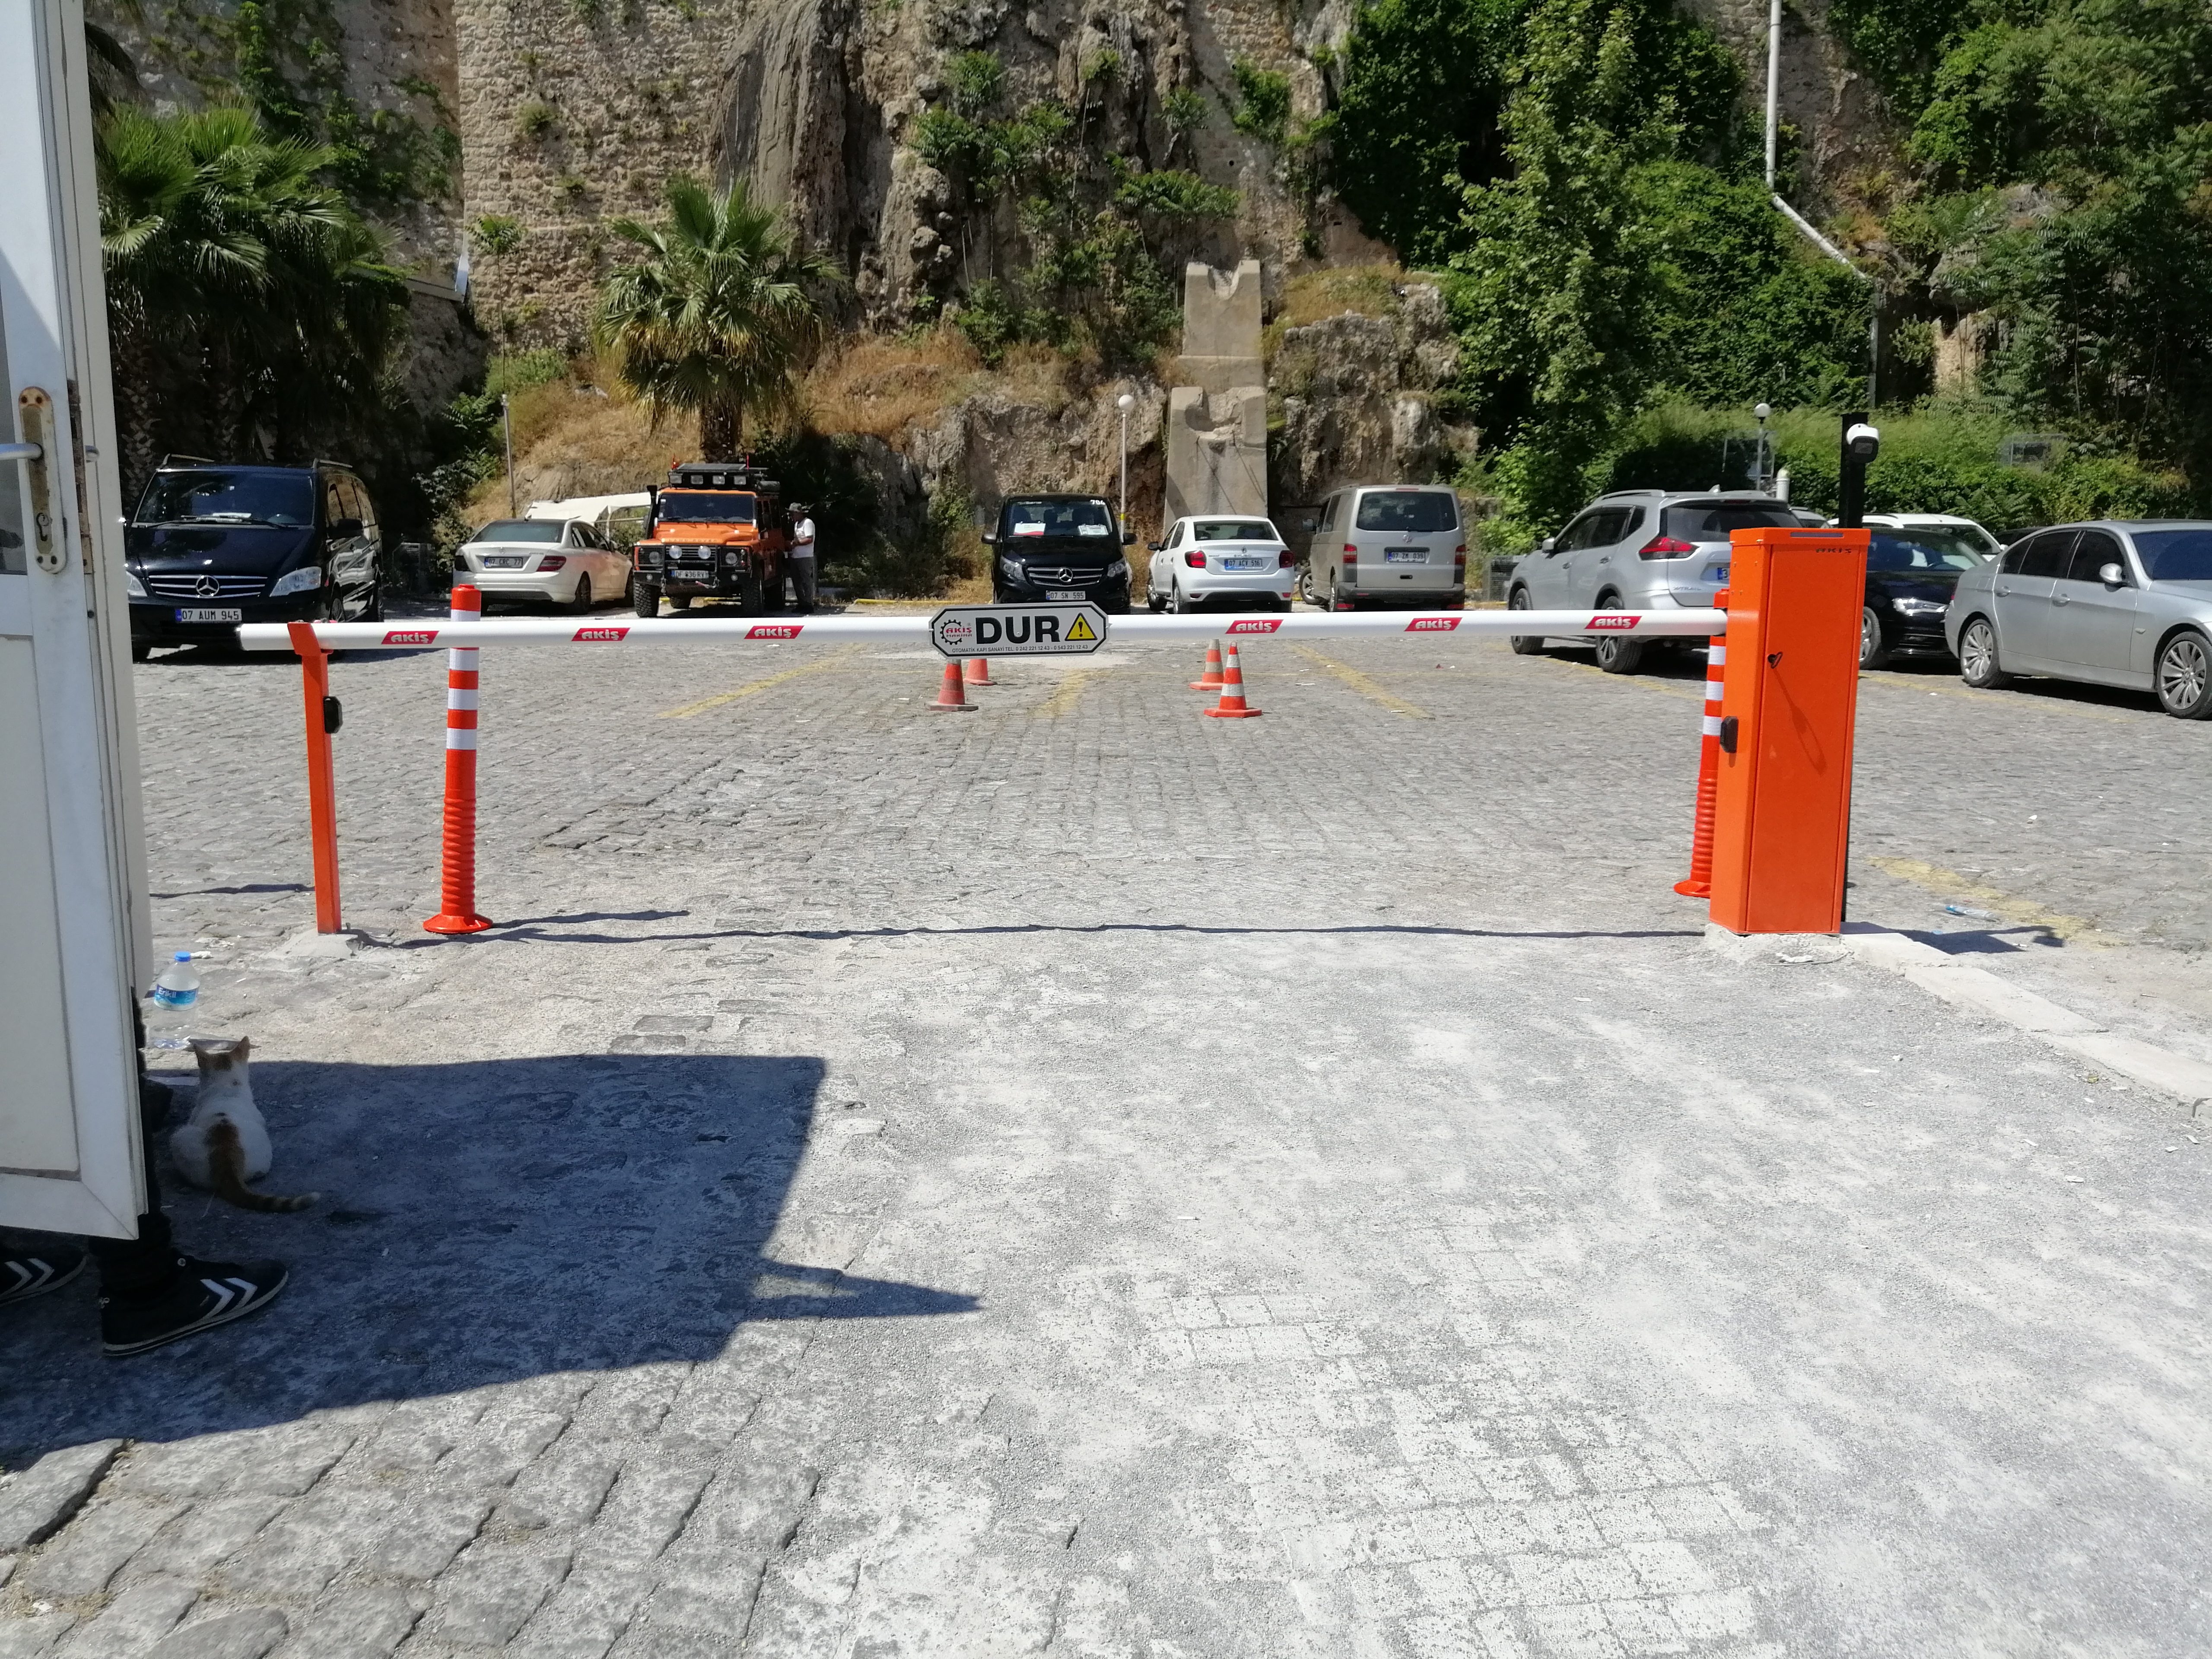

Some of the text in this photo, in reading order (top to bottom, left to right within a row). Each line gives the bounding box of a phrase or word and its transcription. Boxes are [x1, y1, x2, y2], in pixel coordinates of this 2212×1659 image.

[182, 610, 239, 620] 07 AUM 945
[976, 615, 1060, 644] DUR
